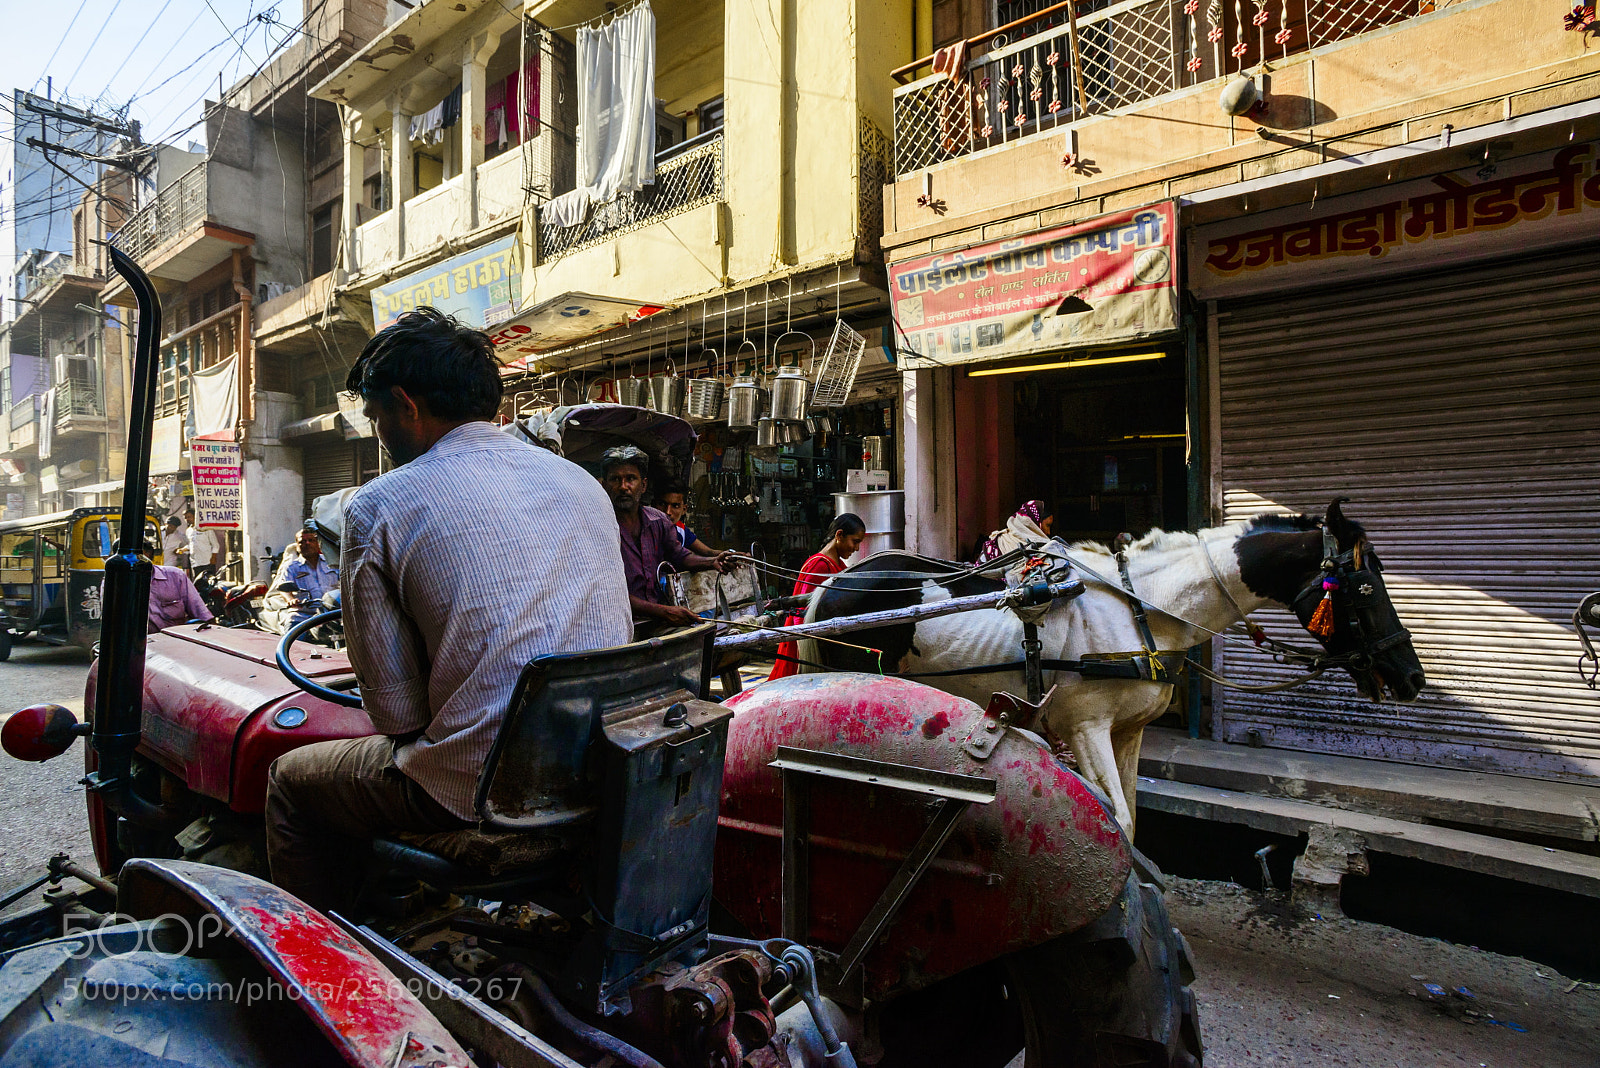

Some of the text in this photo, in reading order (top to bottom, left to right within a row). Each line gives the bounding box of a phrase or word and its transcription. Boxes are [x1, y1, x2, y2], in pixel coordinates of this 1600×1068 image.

[1051, 210, 1166, 264] कम्पनी
[1203, 202, 1403, 277] रजवाड़ा
[214, 489, 240, 497] WEAR
[198, 511, 241, 521] & FRAMES
